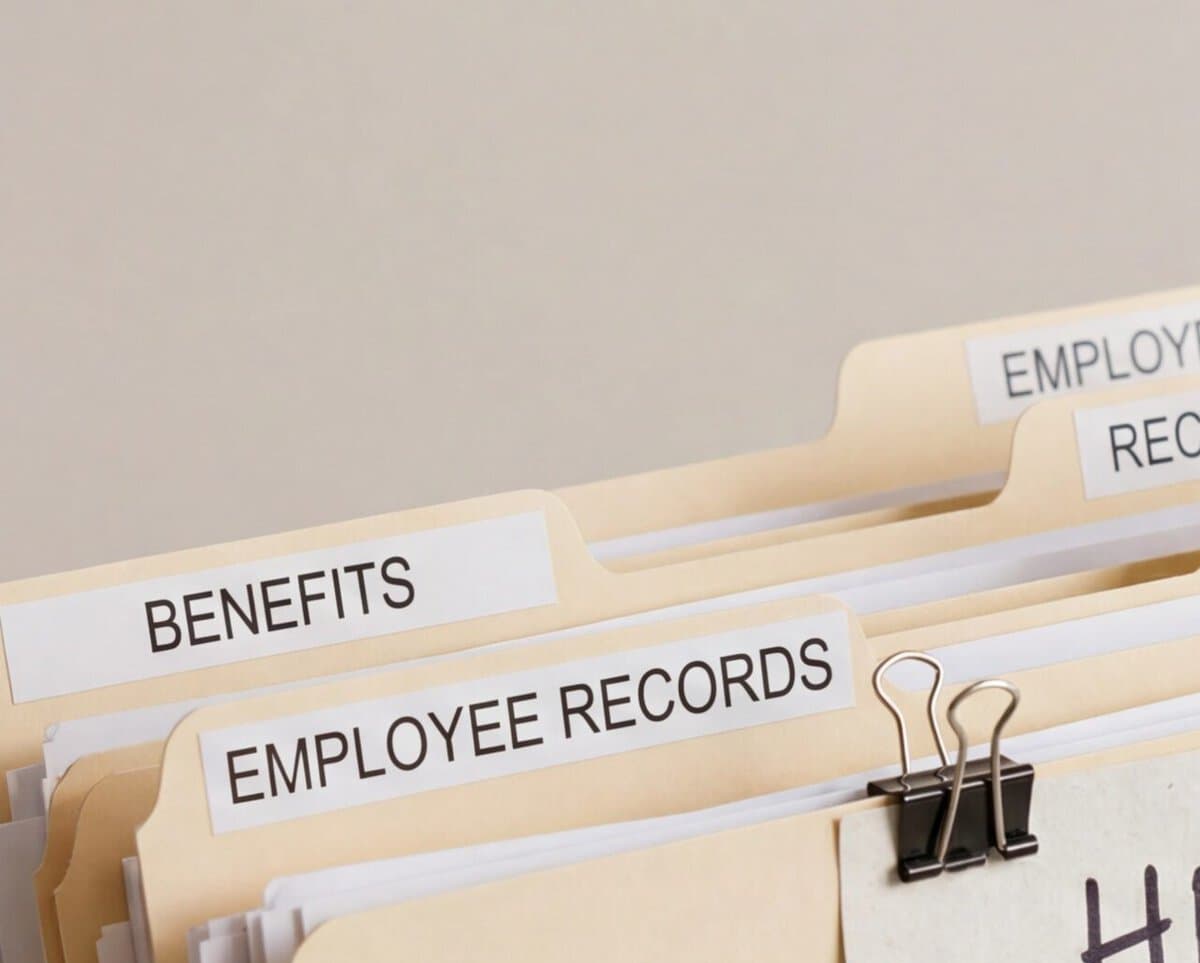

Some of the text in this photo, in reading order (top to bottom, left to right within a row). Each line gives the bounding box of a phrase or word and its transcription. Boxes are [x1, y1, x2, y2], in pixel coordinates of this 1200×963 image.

[144, 556, 415, 653] BENEFITS
[226, 637, 833, 805] EMPLOYEE RECORDS
